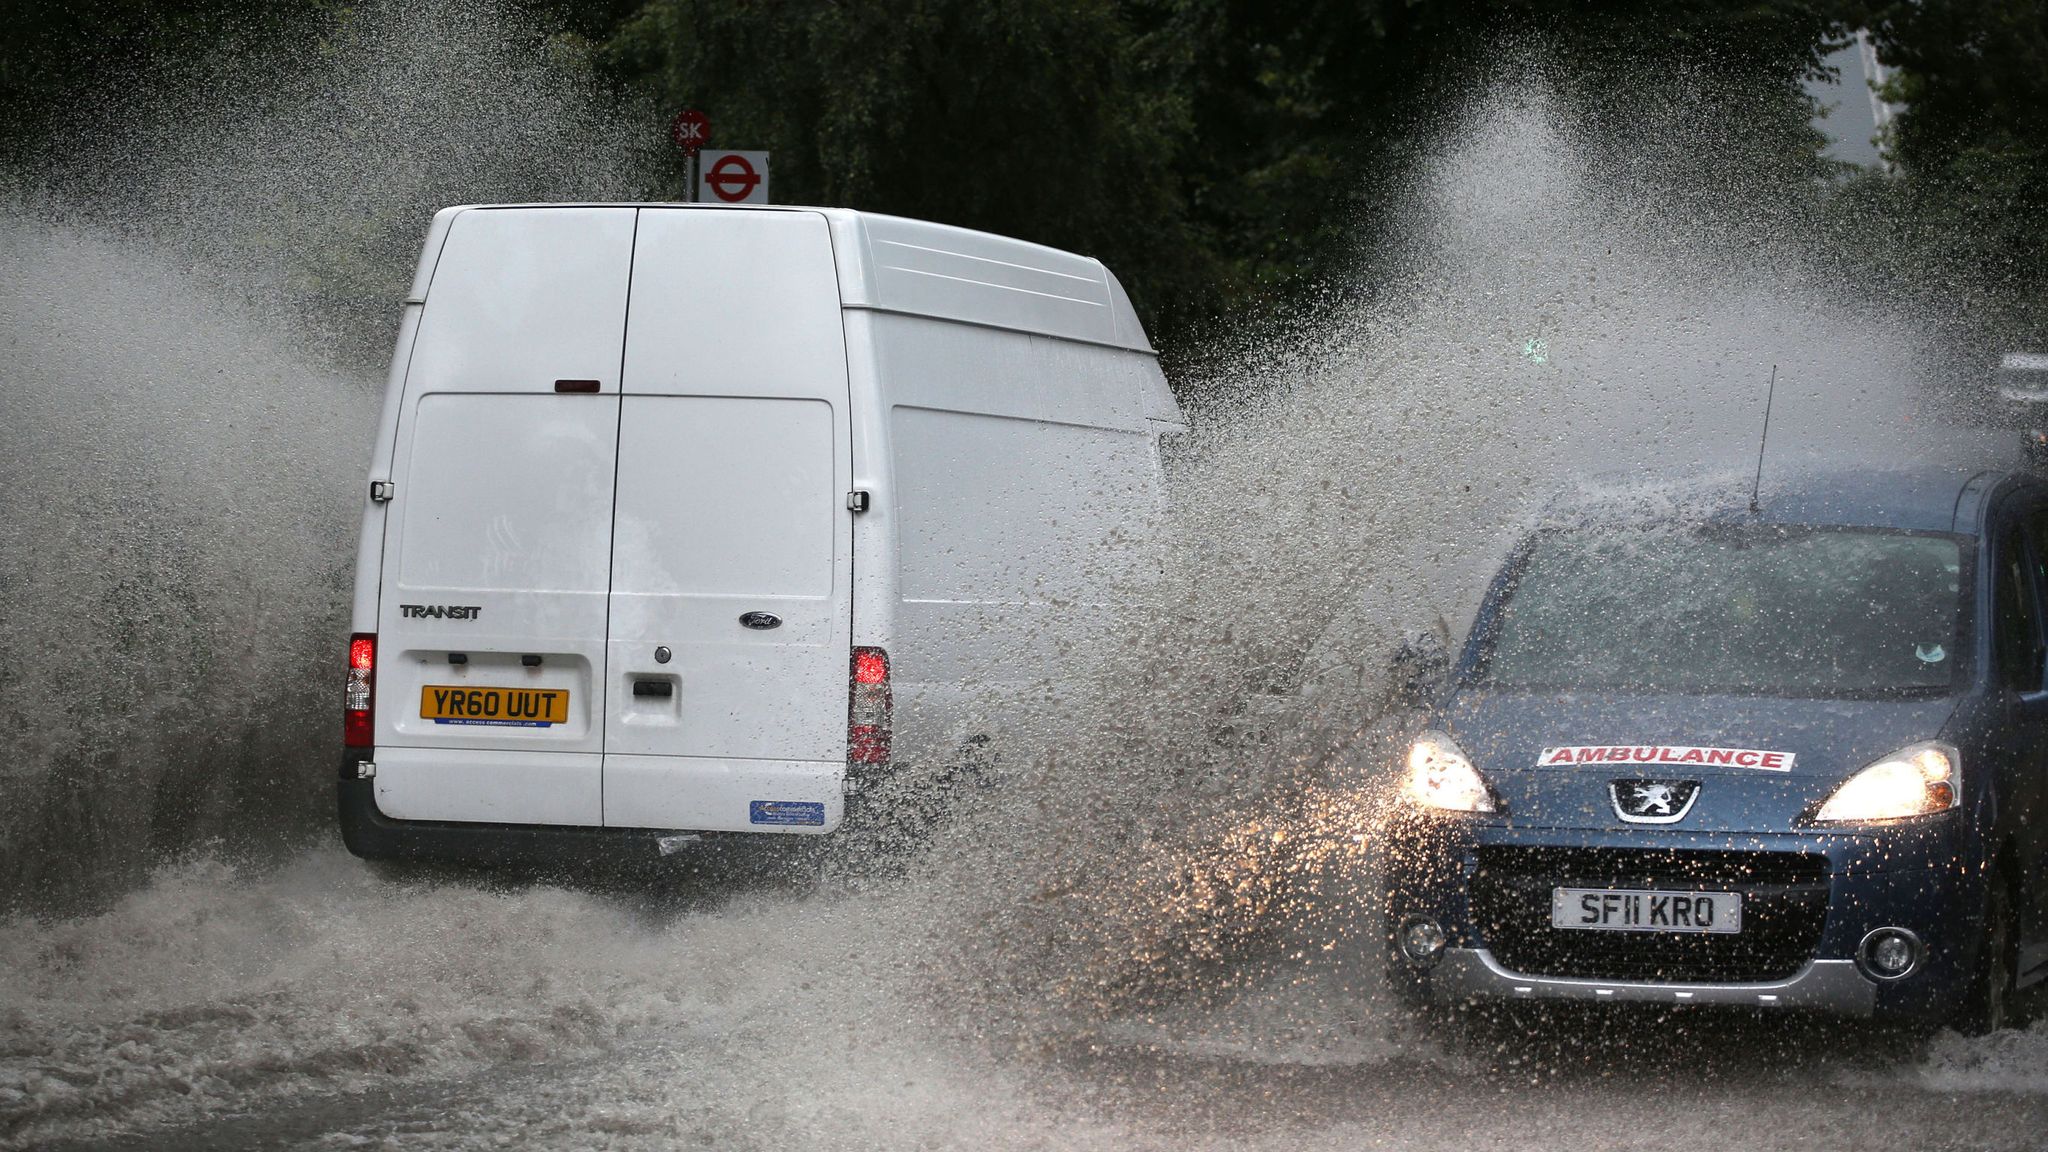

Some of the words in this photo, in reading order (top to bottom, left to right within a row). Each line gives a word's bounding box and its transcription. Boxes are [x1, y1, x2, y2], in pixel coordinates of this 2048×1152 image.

[680, 123, 702, 139] SK
[400, 604, 481, 620] TRANSIT
[748, 613, 773, 626] Ford
[434, 689, 500, 716] YR60
[507, 691, 557, 718] UUT
[1548, 747, 1784, 769] AMBULANCE
[1581, 894, 1640, 925] SF11
[1650, 896, 1714, 927] KRO
